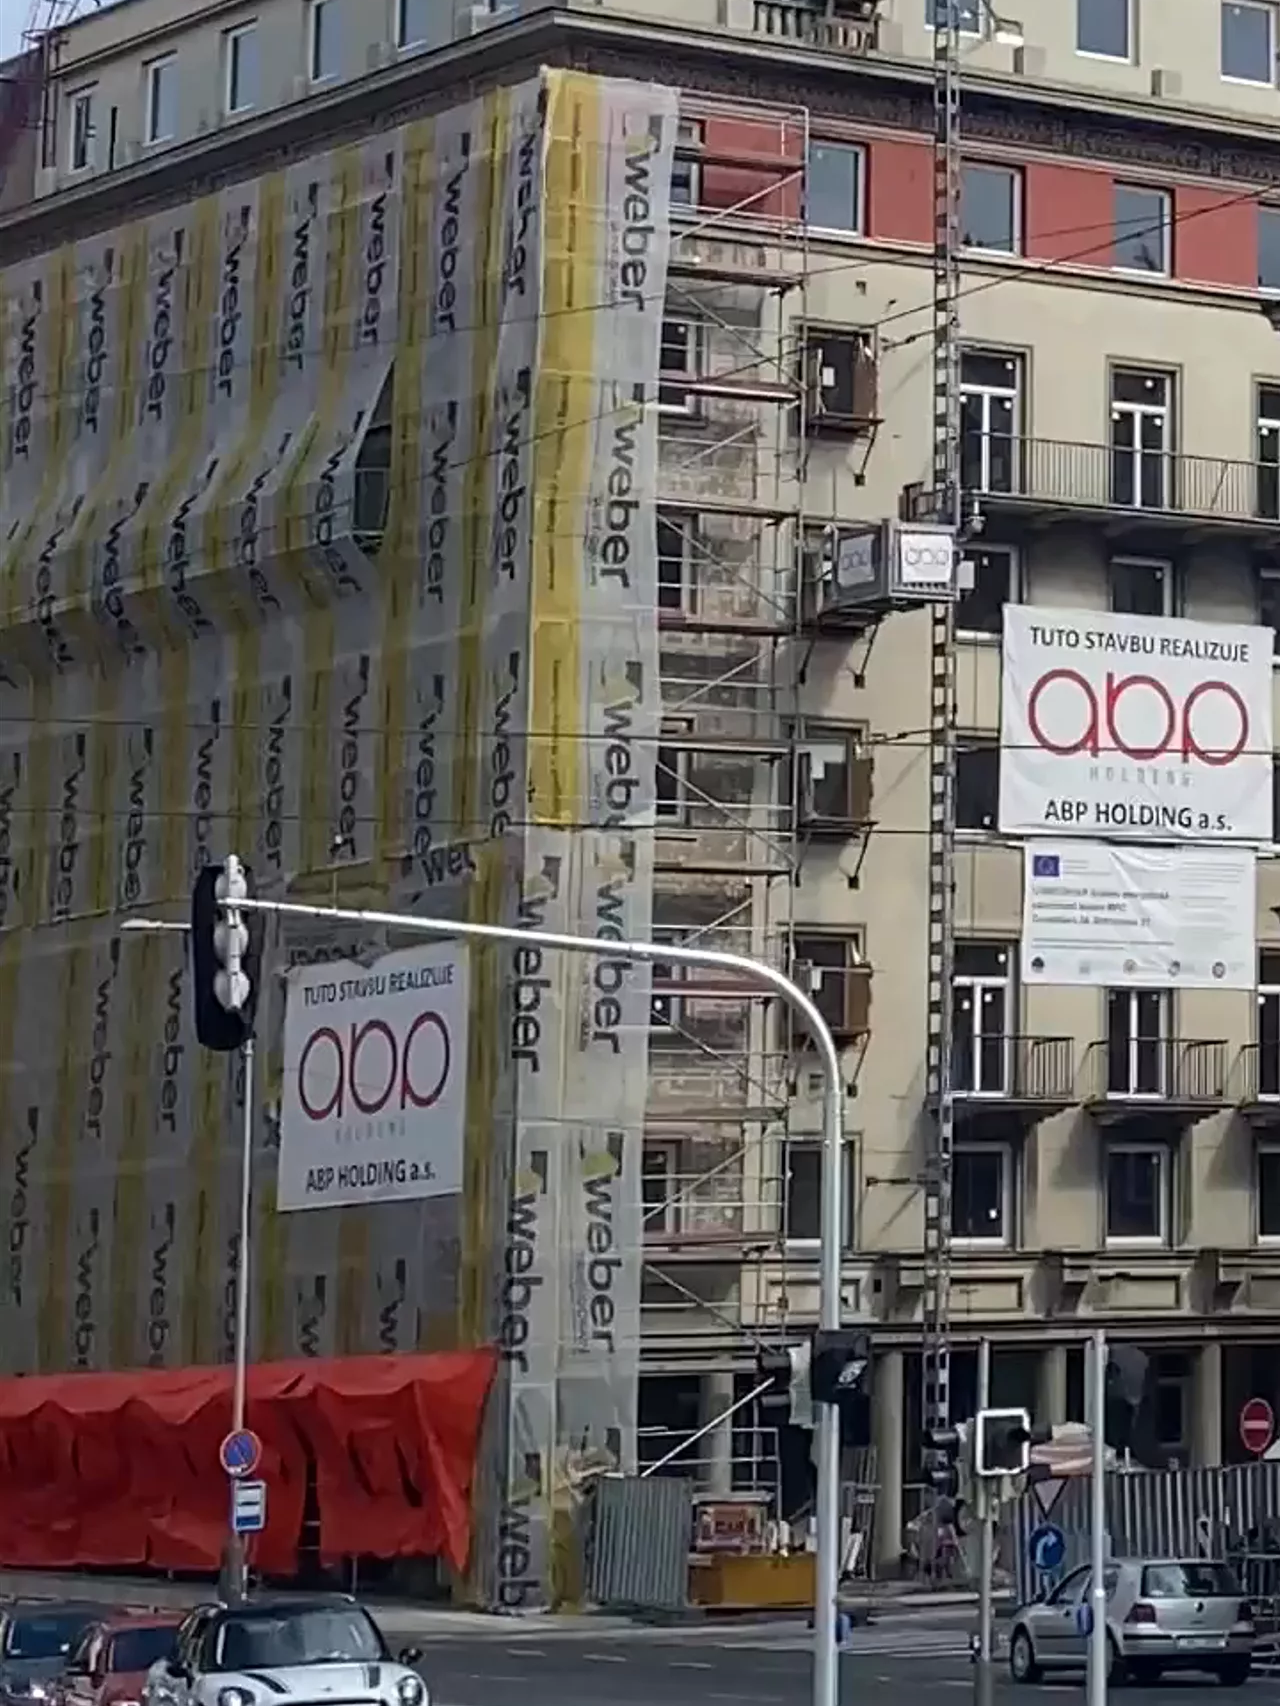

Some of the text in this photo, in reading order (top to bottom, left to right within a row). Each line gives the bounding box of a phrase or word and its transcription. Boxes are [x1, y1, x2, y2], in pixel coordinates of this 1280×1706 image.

[287, 218, 312, 370] weber
[363, 192, 387, 346] weber
[438, 171, 462, 330] weber
[620, 150, 655, 313] weber
[15, 315, 38, 461] weber
[85, 285, 107, 433] weber
[147, 268, 174, 421] weber
[218, 243, 242, 398] weber
[315, 443, 362, 592] weber
[427, 439, 449, 605] weber
[500, 413, 526, 581] weber
[600, 423, 640, 588] weber
[1028, 668, 1249, 766] abp
[1030, 626, 1250, 663] TUTO STAVBU REALIZUJE
[338, 694, 361, 857] weber
[414, 712, 438, 856] webe
[491, 693, 515, 838] webe
[1044, 799, 1233, 832] ABP HOLDING a.s.
[161, 968, 185, 1132] weber
[304, 982, 336, 1007] TUTO
[511, 896, 552, 1073] weber
[306, 1167, 334, 1193] ABP
[338, 1159, 406, 1189] HOLDING
[501, 1193, 543, 1374] weber
[583, 1173, 622, 1354] weber
